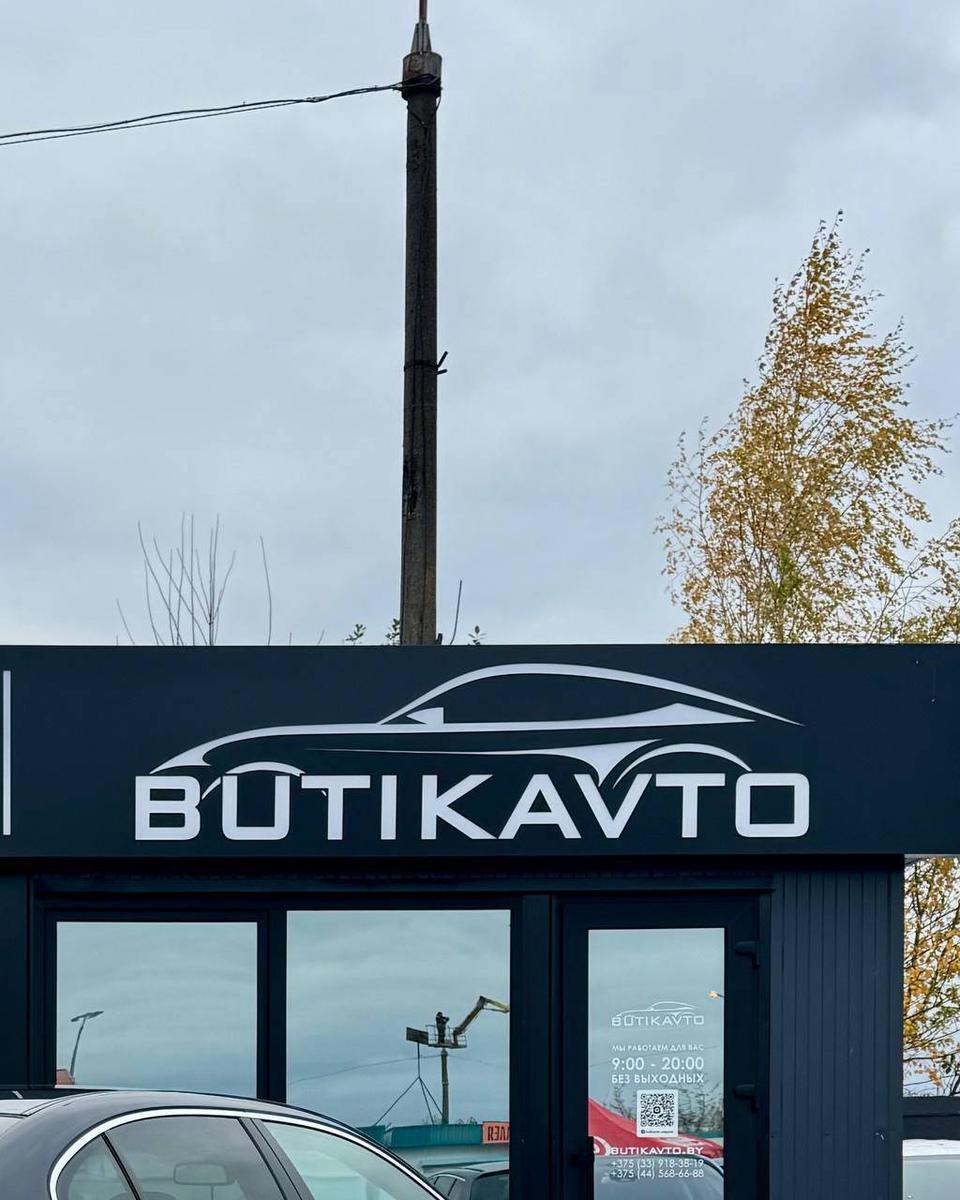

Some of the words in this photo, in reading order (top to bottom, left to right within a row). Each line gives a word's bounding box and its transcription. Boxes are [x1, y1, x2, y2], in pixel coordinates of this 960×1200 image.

[134, 772, 811, 841] BUTIKAVTO
[611, 1015, 704, 1026] BUTIKAVTO
[612, 1044, 626, 1052] МЫ
[627, 1044, 668, 1052] РАБОТАЕМ
[670, 1044, 687, 1052] ДЛЯ
[612, 1057, 644, 1070] 9:00
[662, 1057, 704, 1070] 20:00
[611, 1074, 630, 1084] БЕЗ
[634, 1073, 704, 1084] ВЫХОДНЫХ
[611, 1146, 704, 1155] BUTIKAVTO.BY
[610, 1159, 635, 1168] +375
[637, 1159, 655, 1170] (33)
[610, 1169, 635, 1178] +375
[637, 1169, 655, 1180] (44)
[658, 1169, 704, 1178] 568-66-88
